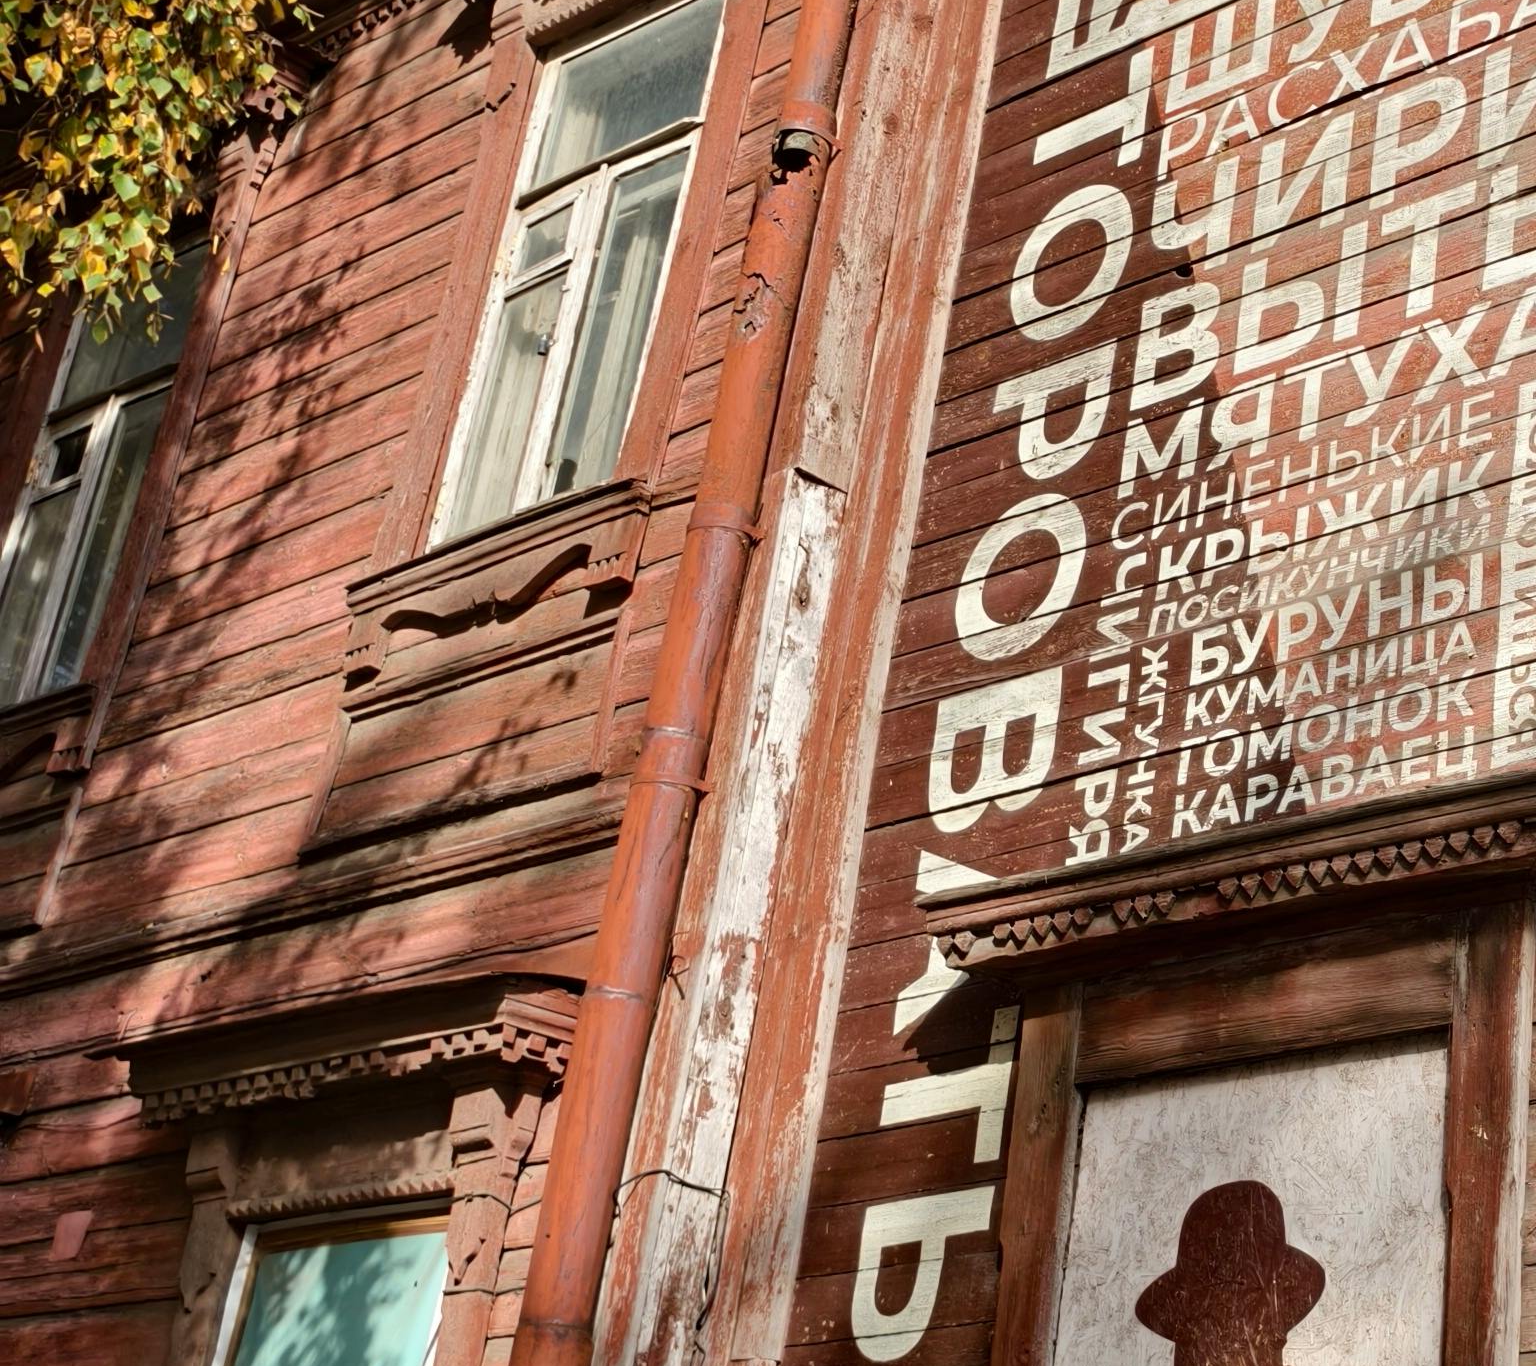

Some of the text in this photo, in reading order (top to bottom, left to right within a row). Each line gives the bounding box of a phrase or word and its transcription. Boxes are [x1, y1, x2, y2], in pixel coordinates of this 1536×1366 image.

[1107, 389, 1495, 554] СИНЕНЬКИЕ
[1153, 450, 1496, 602] КРЫЖИК
[1147, 512, 1491, 638] ПОСИКУНЧИКИ
[1186, 551, 1485, 687] БУРУНЫ
[1063, 551, 1148, 866] ЧИГИРЯ
[1175, 667, 1477, 786] ГОМОНОК
[1182, 617, 1480, 731] КУМАНИЦА
[1118, 639, 1172, 854] ЖГУЧКА
[1170, 723, 1480, 839] КАРАВАЕЦ
